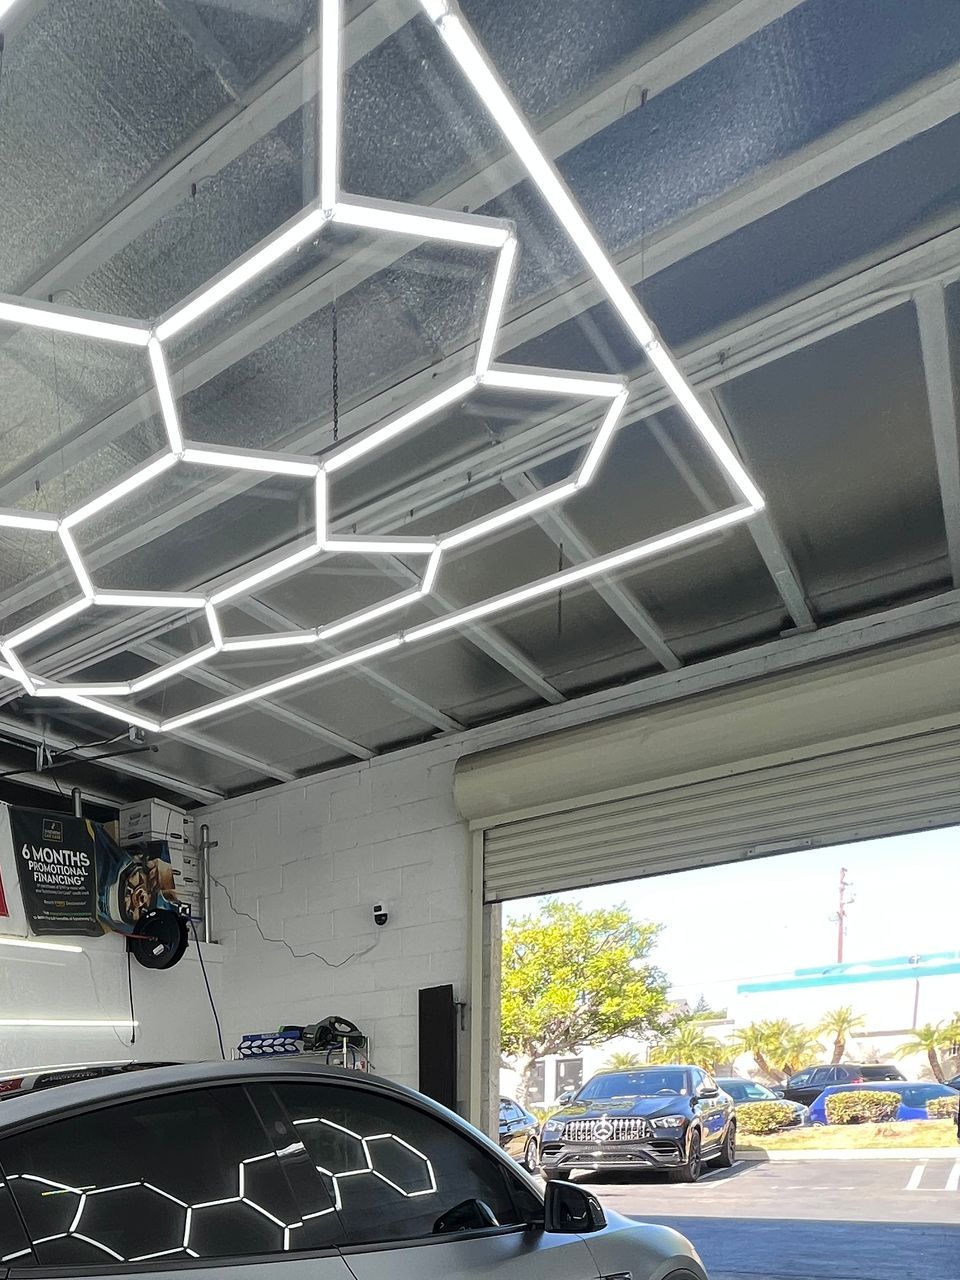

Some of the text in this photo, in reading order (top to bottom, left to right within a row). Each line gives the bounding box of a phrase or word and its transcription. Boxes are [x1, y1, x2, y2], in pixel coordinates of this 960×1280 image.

[21, 843, 91, 867] 6 MONTHS
[28, 860, 89, 876] PROMOTIONAL
